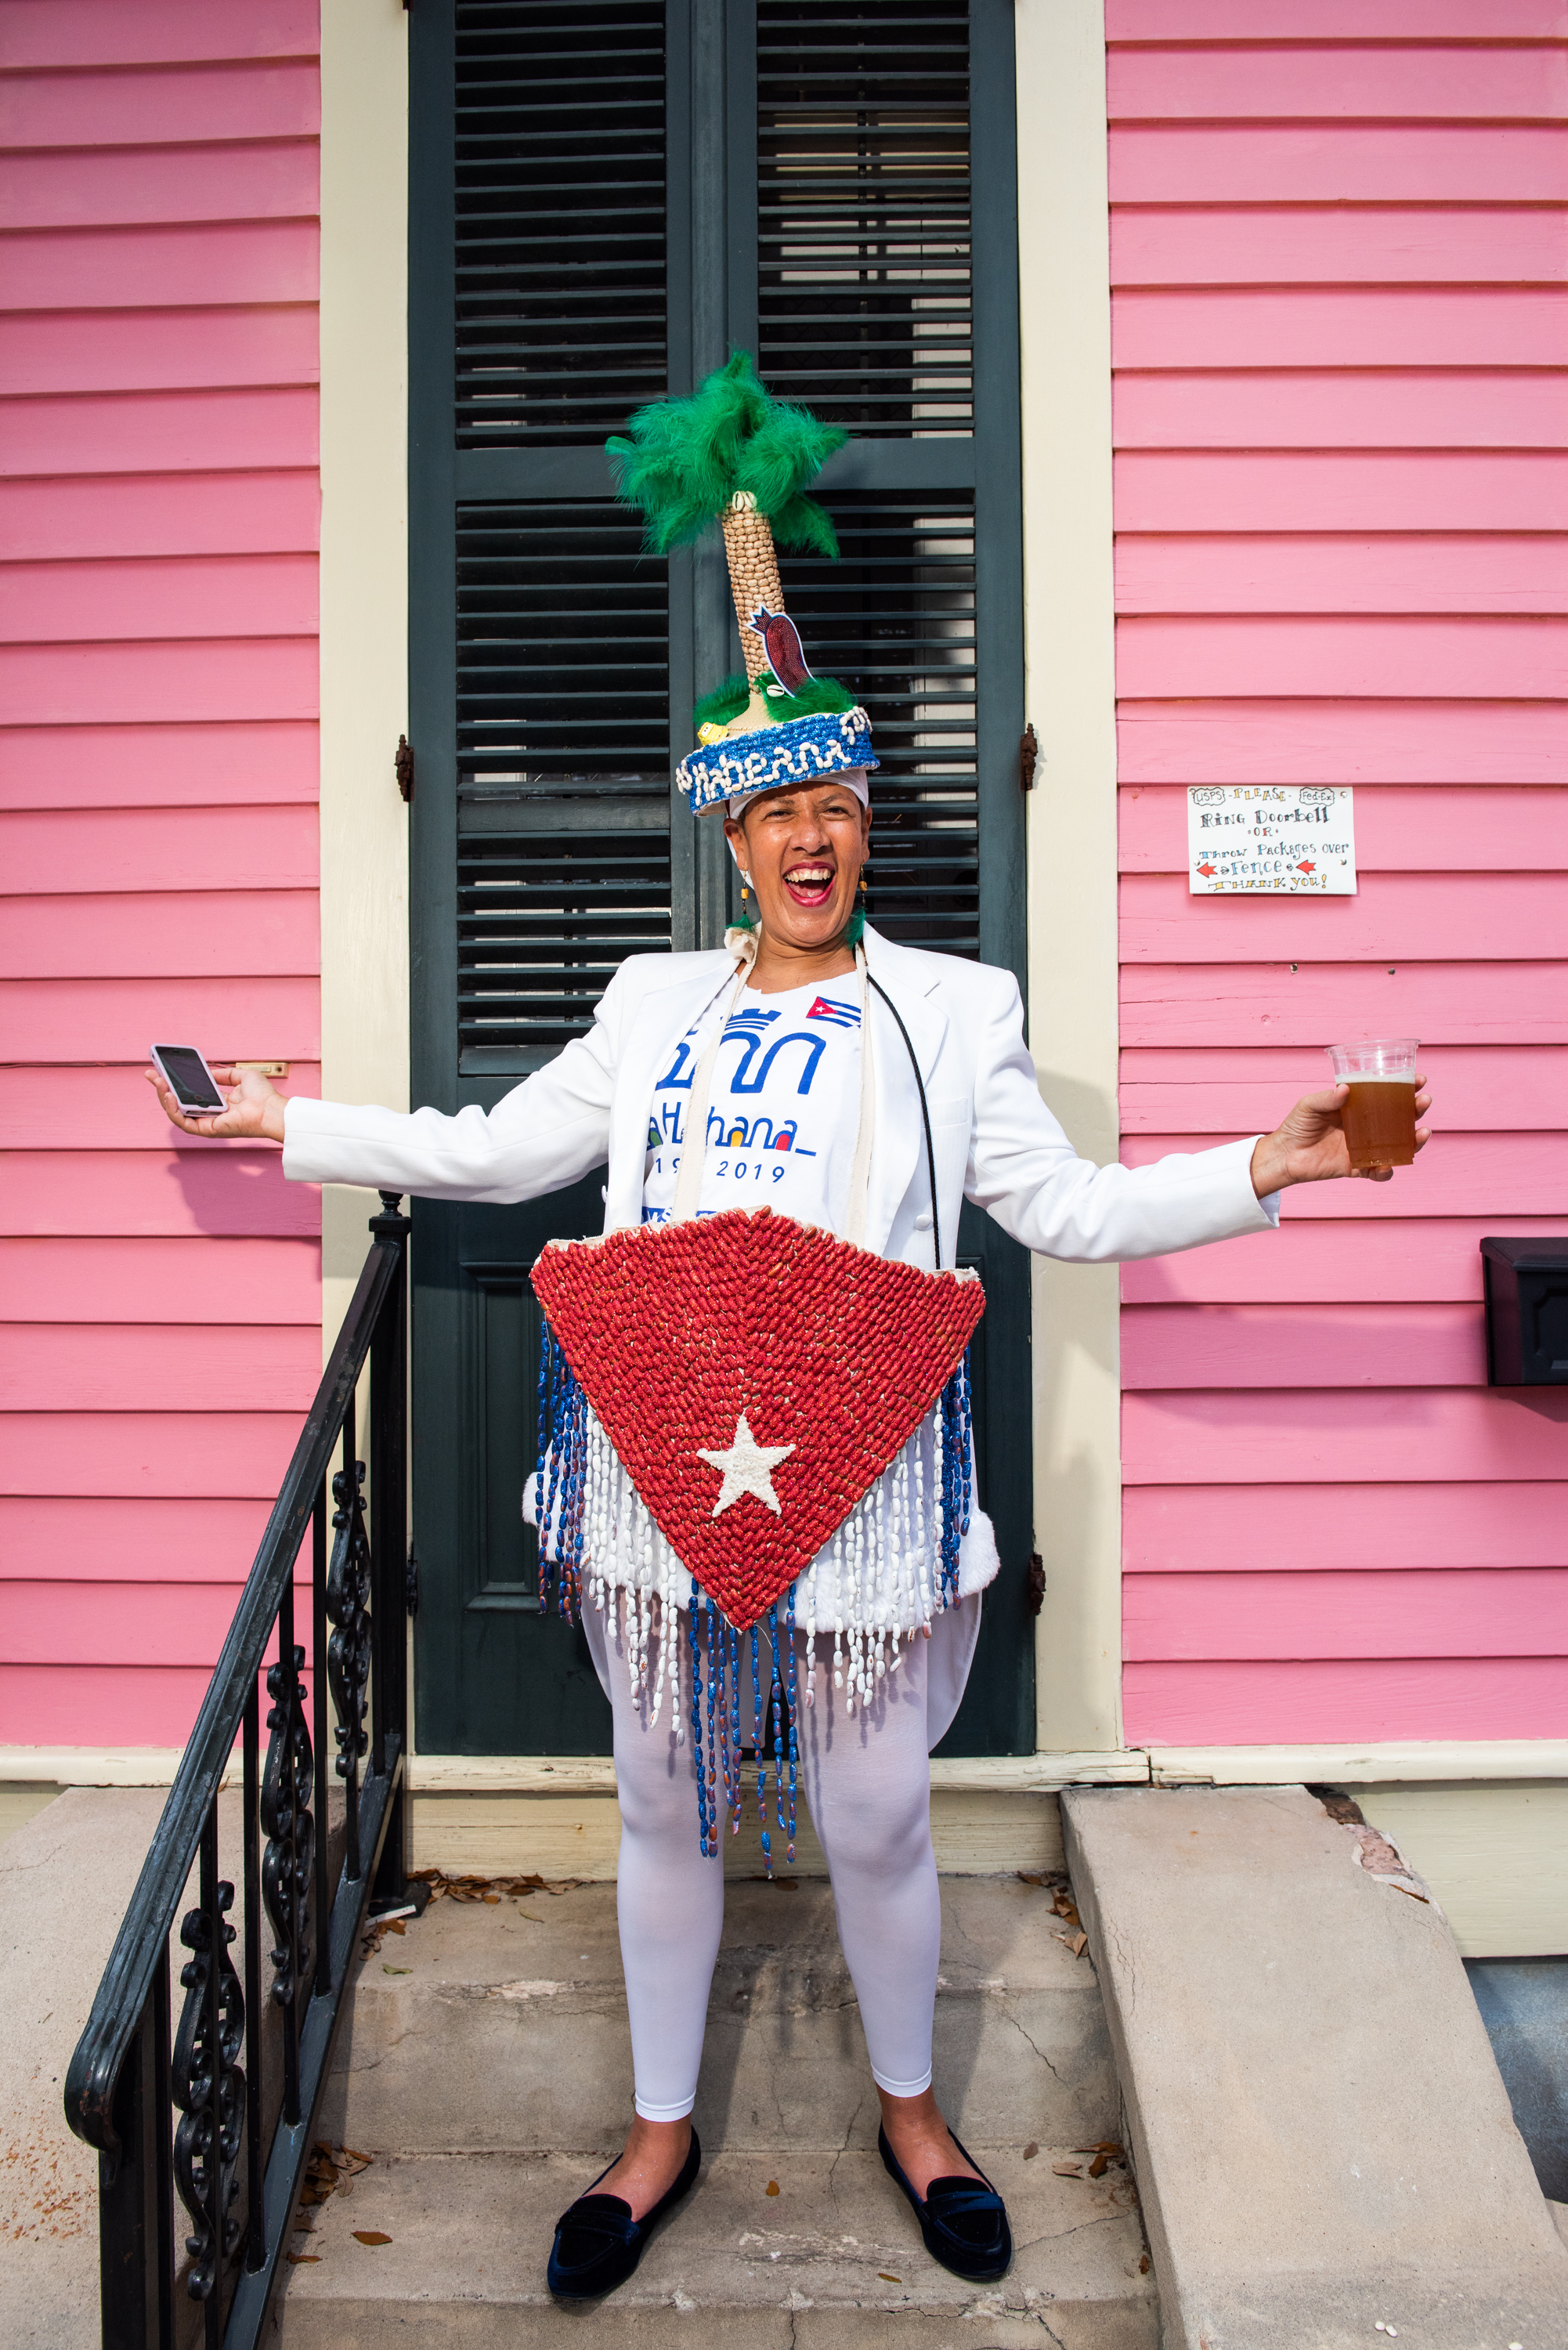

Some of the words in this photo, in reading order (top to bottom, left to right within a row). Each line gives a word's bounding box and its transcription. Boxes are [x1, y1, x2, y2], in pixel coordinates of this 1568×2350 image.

[1197, 790, 1222, 802] USPS
[1255, 807, 1330, 824] Doorbell
[1258, 842, 1316, 860] Packages
[1322, 843, 1349, 853] over
[1230, 860, 1281, 875] Fence
[1291, 874, 1327, 891] you!
[717, 1161, 784, 1183] 2019
